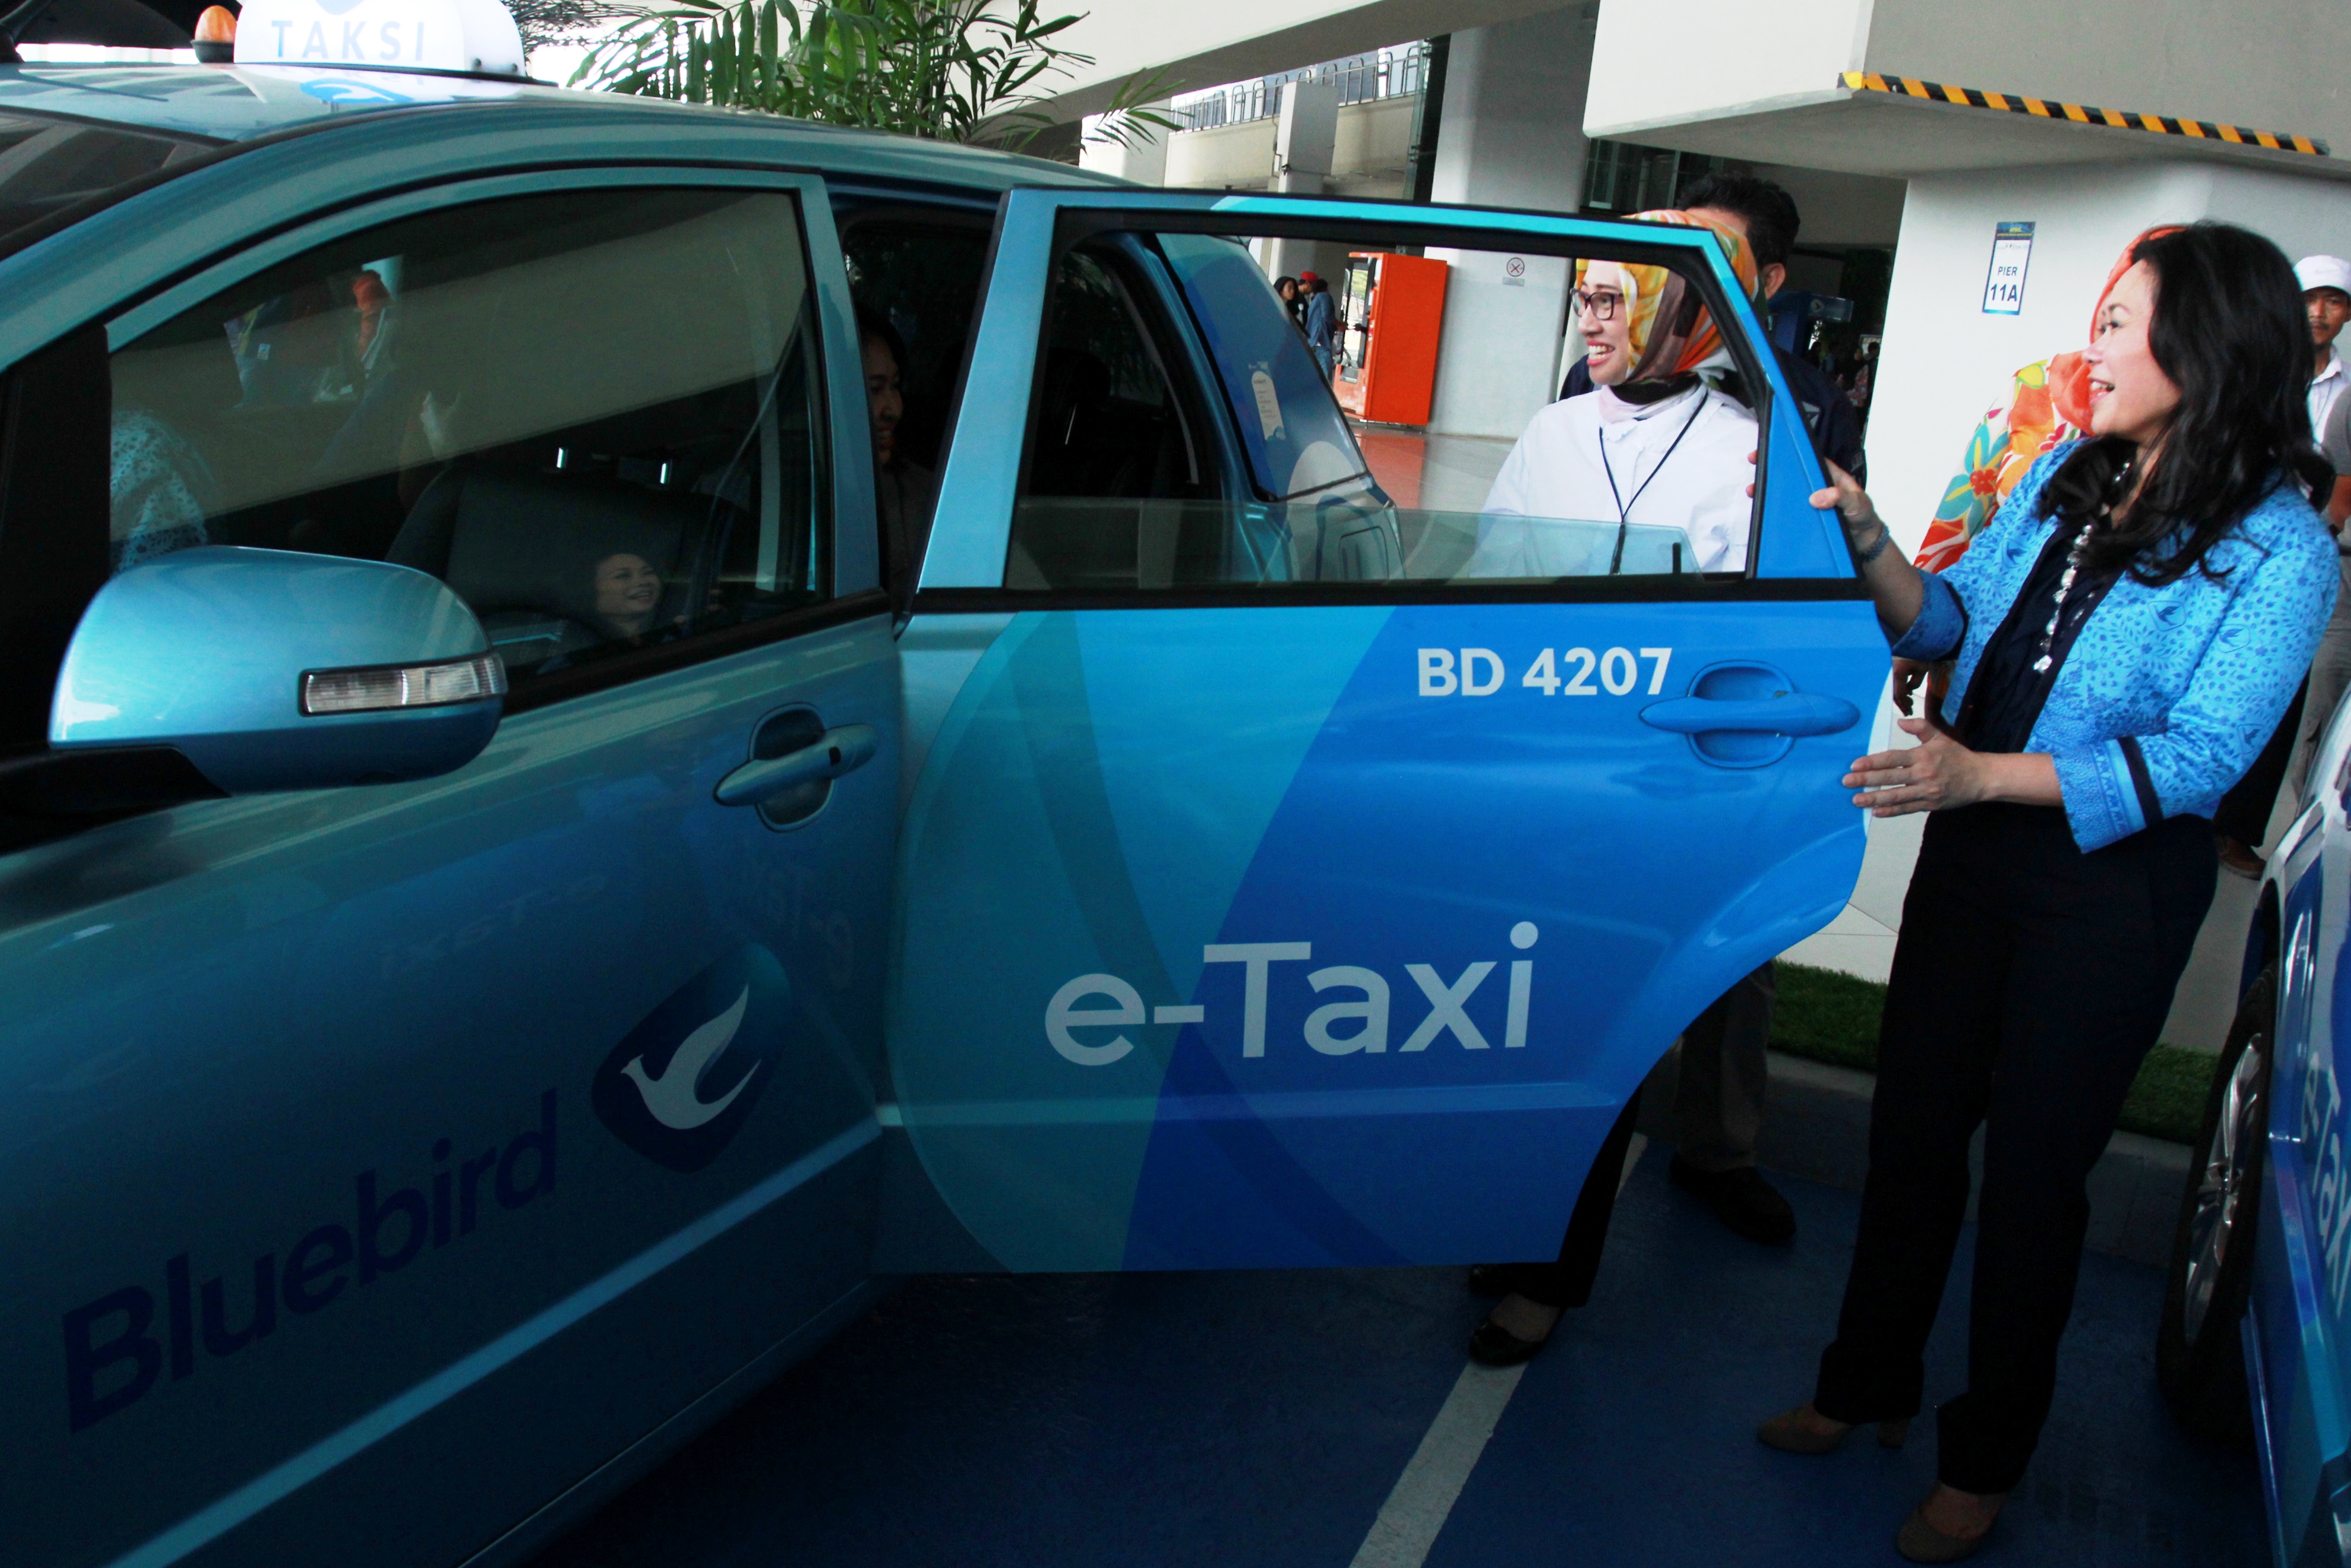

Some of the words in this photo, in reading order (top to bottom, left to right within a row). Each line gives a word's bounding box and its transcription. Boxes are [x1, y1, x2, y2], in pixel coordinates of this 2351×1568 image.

[271, 19, 425, 61] TAKSI
[1991, 283, 2018, 302] 11A
[1997, 266, 2018, 276] PIER
[1417, 647, 1505, 696] BD
[1522, 647, 1672, 696] 4207
[1044, 921, 1539, 1066] e-Taxi
[62, 1088, 557, 1433] Bluebird
